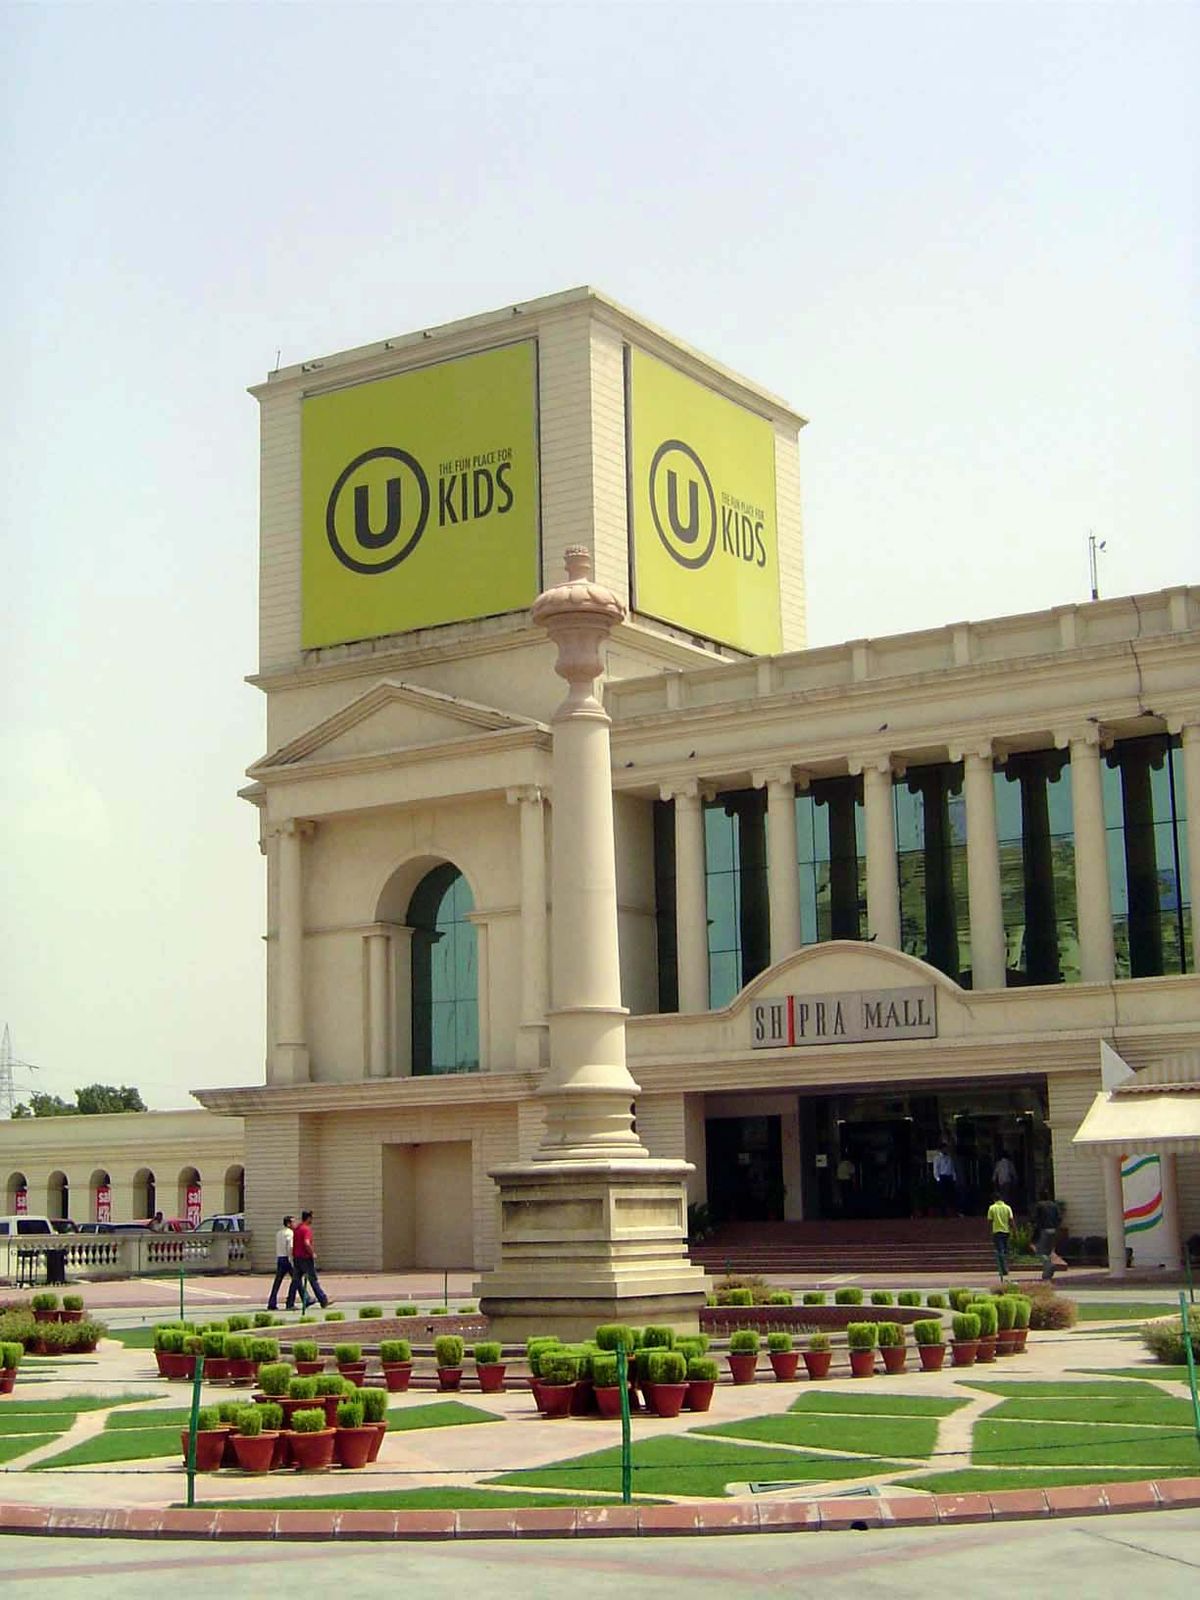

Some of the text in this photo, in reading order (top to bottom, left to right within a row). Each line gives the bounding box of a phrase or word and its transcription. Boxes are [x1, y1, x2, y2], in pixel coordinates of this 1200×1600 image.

[439, 447, 512, 476] THE FUN PLACE FOR
[354, 477, 401, 549] U
[439, 462, 514, 527] KIDS
[667, 470, 699, 543] U
[722, 506, 766, 568] KIDS
[755, 995, 931, 1047] SHIPRA MALL
